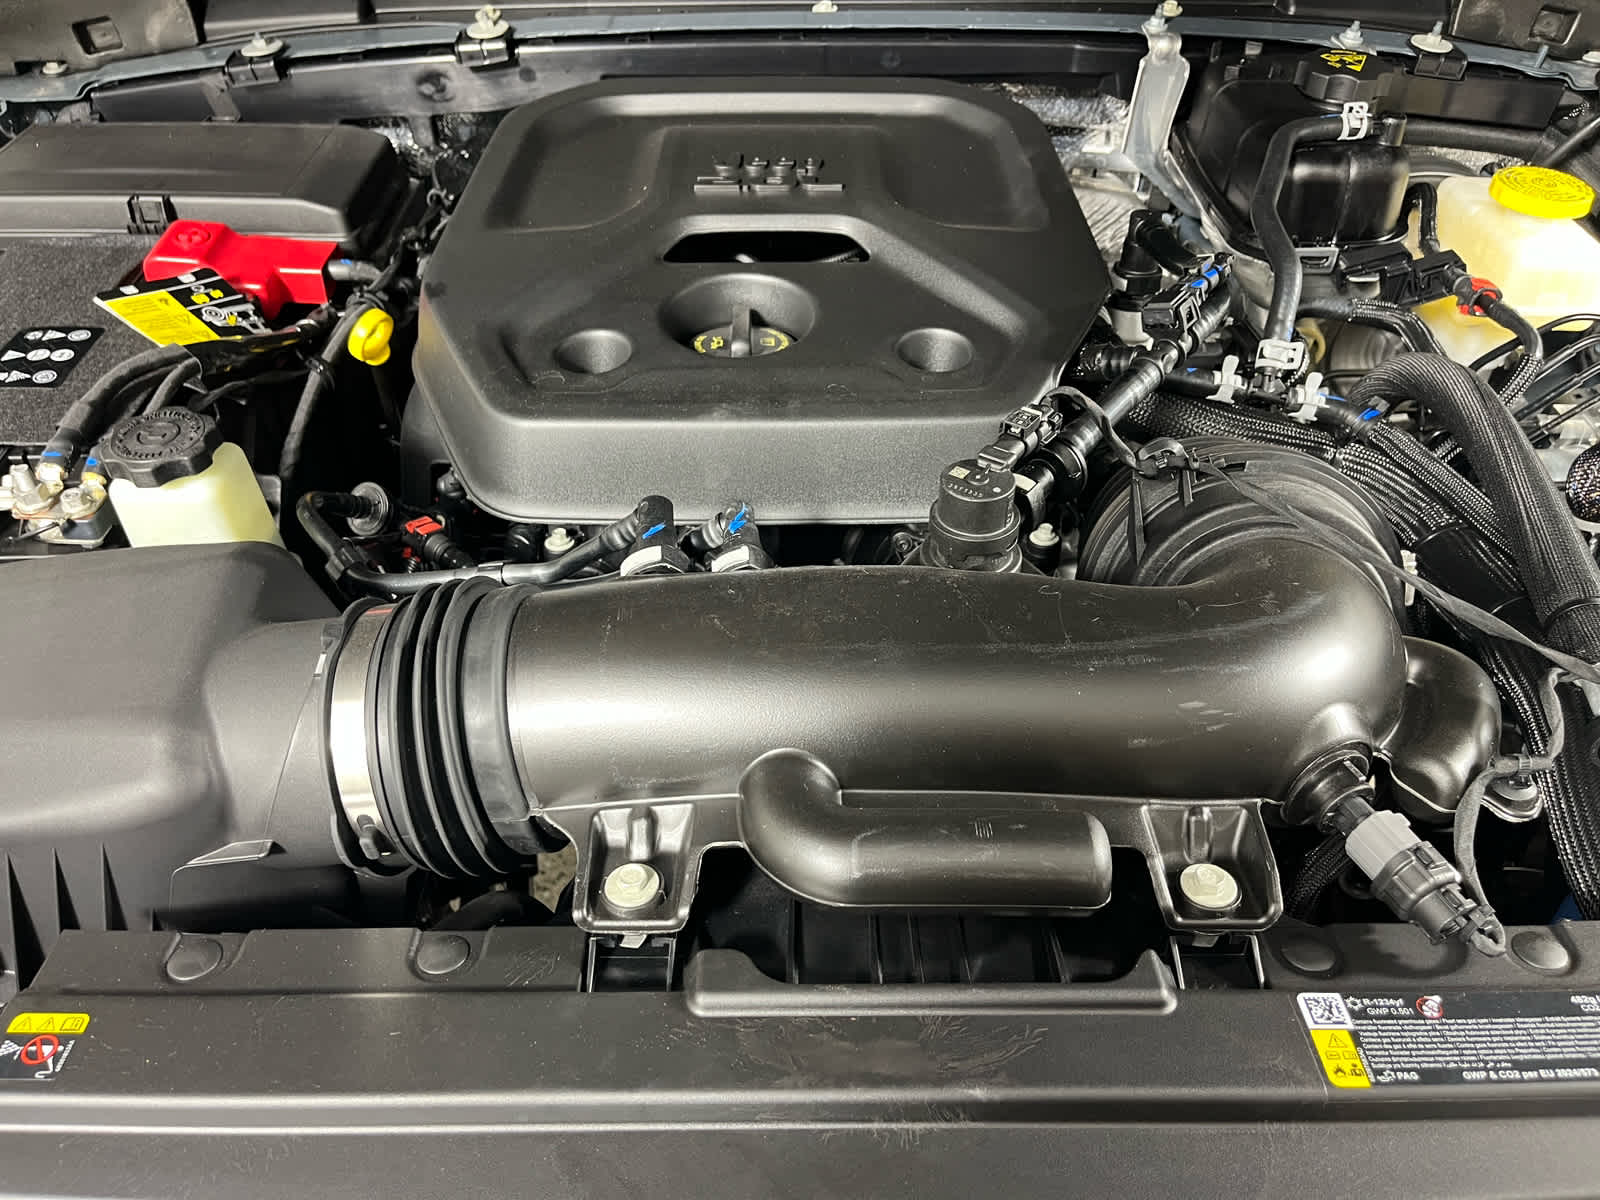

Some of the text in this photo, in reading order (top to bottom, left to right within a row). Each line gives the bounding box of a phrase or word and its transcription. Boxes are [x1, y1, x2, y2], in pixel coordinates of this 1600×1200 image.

[1366, 1007, 1390, 1015] GWP
[1462, 1070, 1487, 1079] GWP
[1498, 1070, 1521, 1079] CO2
[1538, 1069, 1555, 1078] EU
